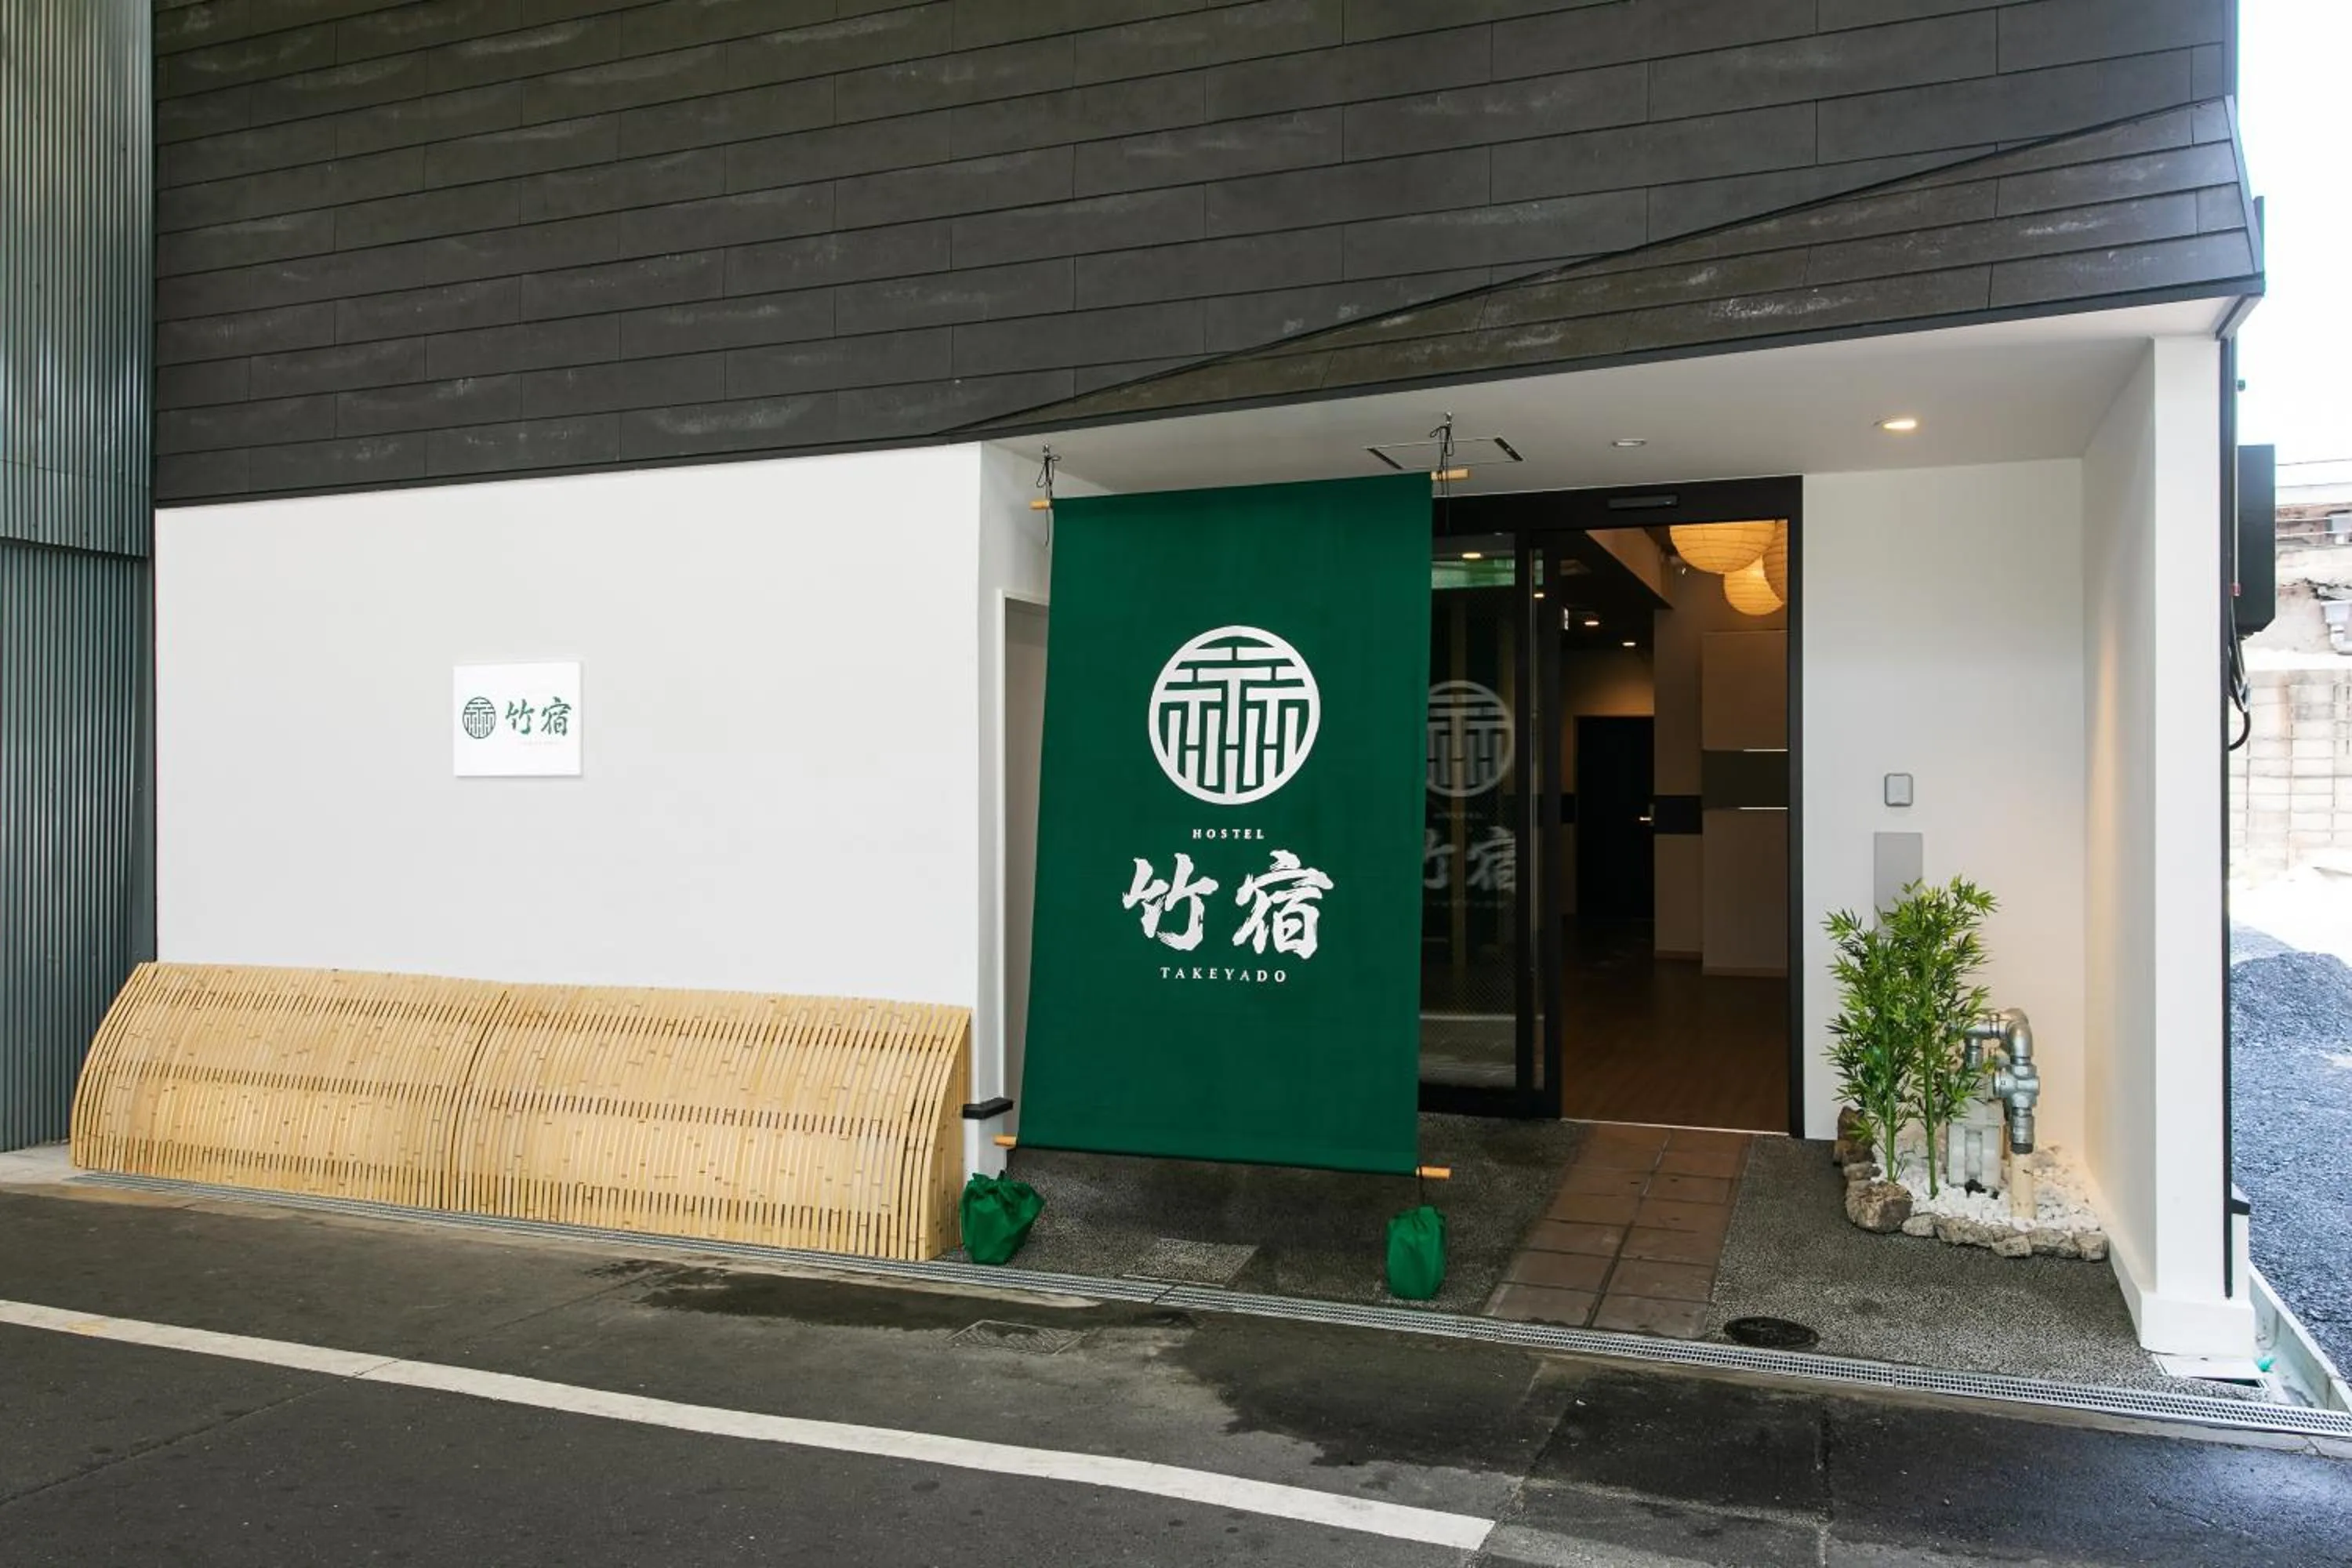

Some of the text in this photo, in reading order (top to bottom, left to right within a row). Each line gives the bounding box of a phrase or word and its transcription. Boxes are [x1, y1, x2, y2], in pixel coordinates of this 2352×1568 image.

[506, 696, 572, 736] 竹宿
[1192, 828, 1265, 840] HOSTEL
[1122, 849, 1334, 960] 竹宿
[1160, 967, 1287, 983] TAKEYADO
